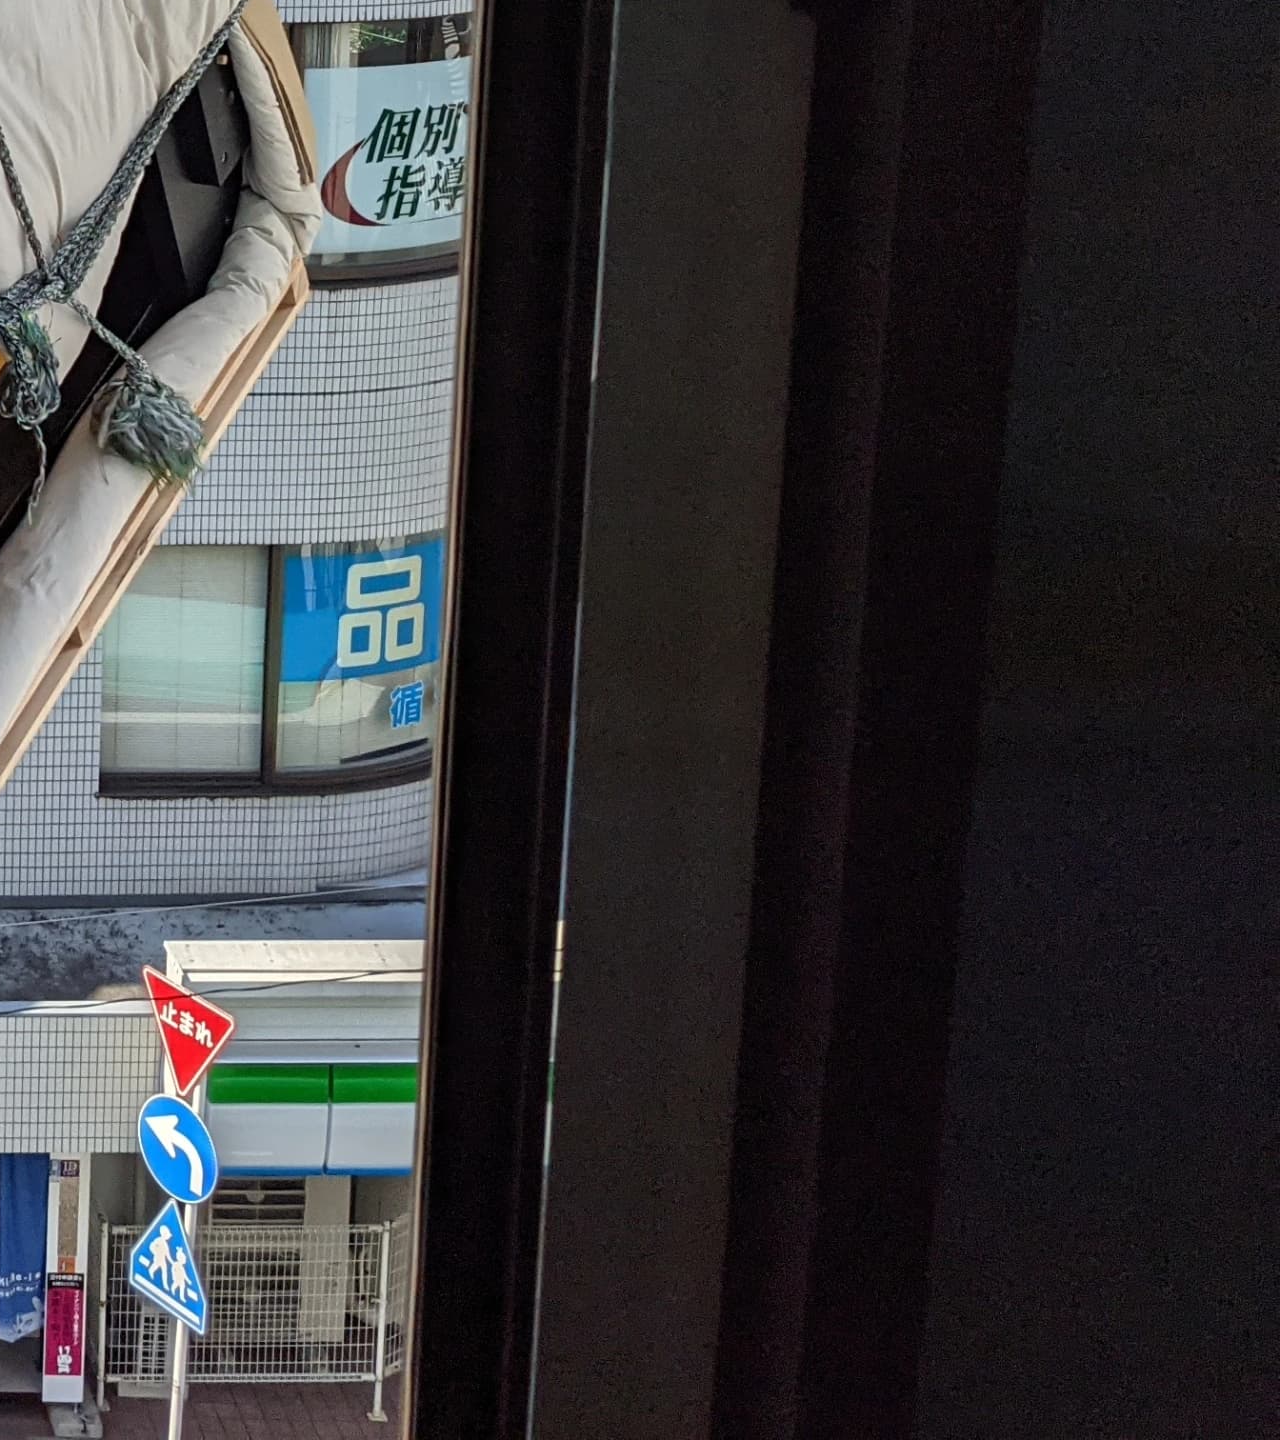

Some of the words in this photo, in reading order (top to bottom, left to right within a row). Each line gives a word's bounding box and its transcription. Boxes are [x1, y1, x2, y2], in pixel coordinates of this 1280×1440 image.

[360, 101, 465, 163] 個別
[374, 156, 465, 221] 指導
[389, 680, 424, 729] 循
[160, 1001, 214, 1048] 止まれ
